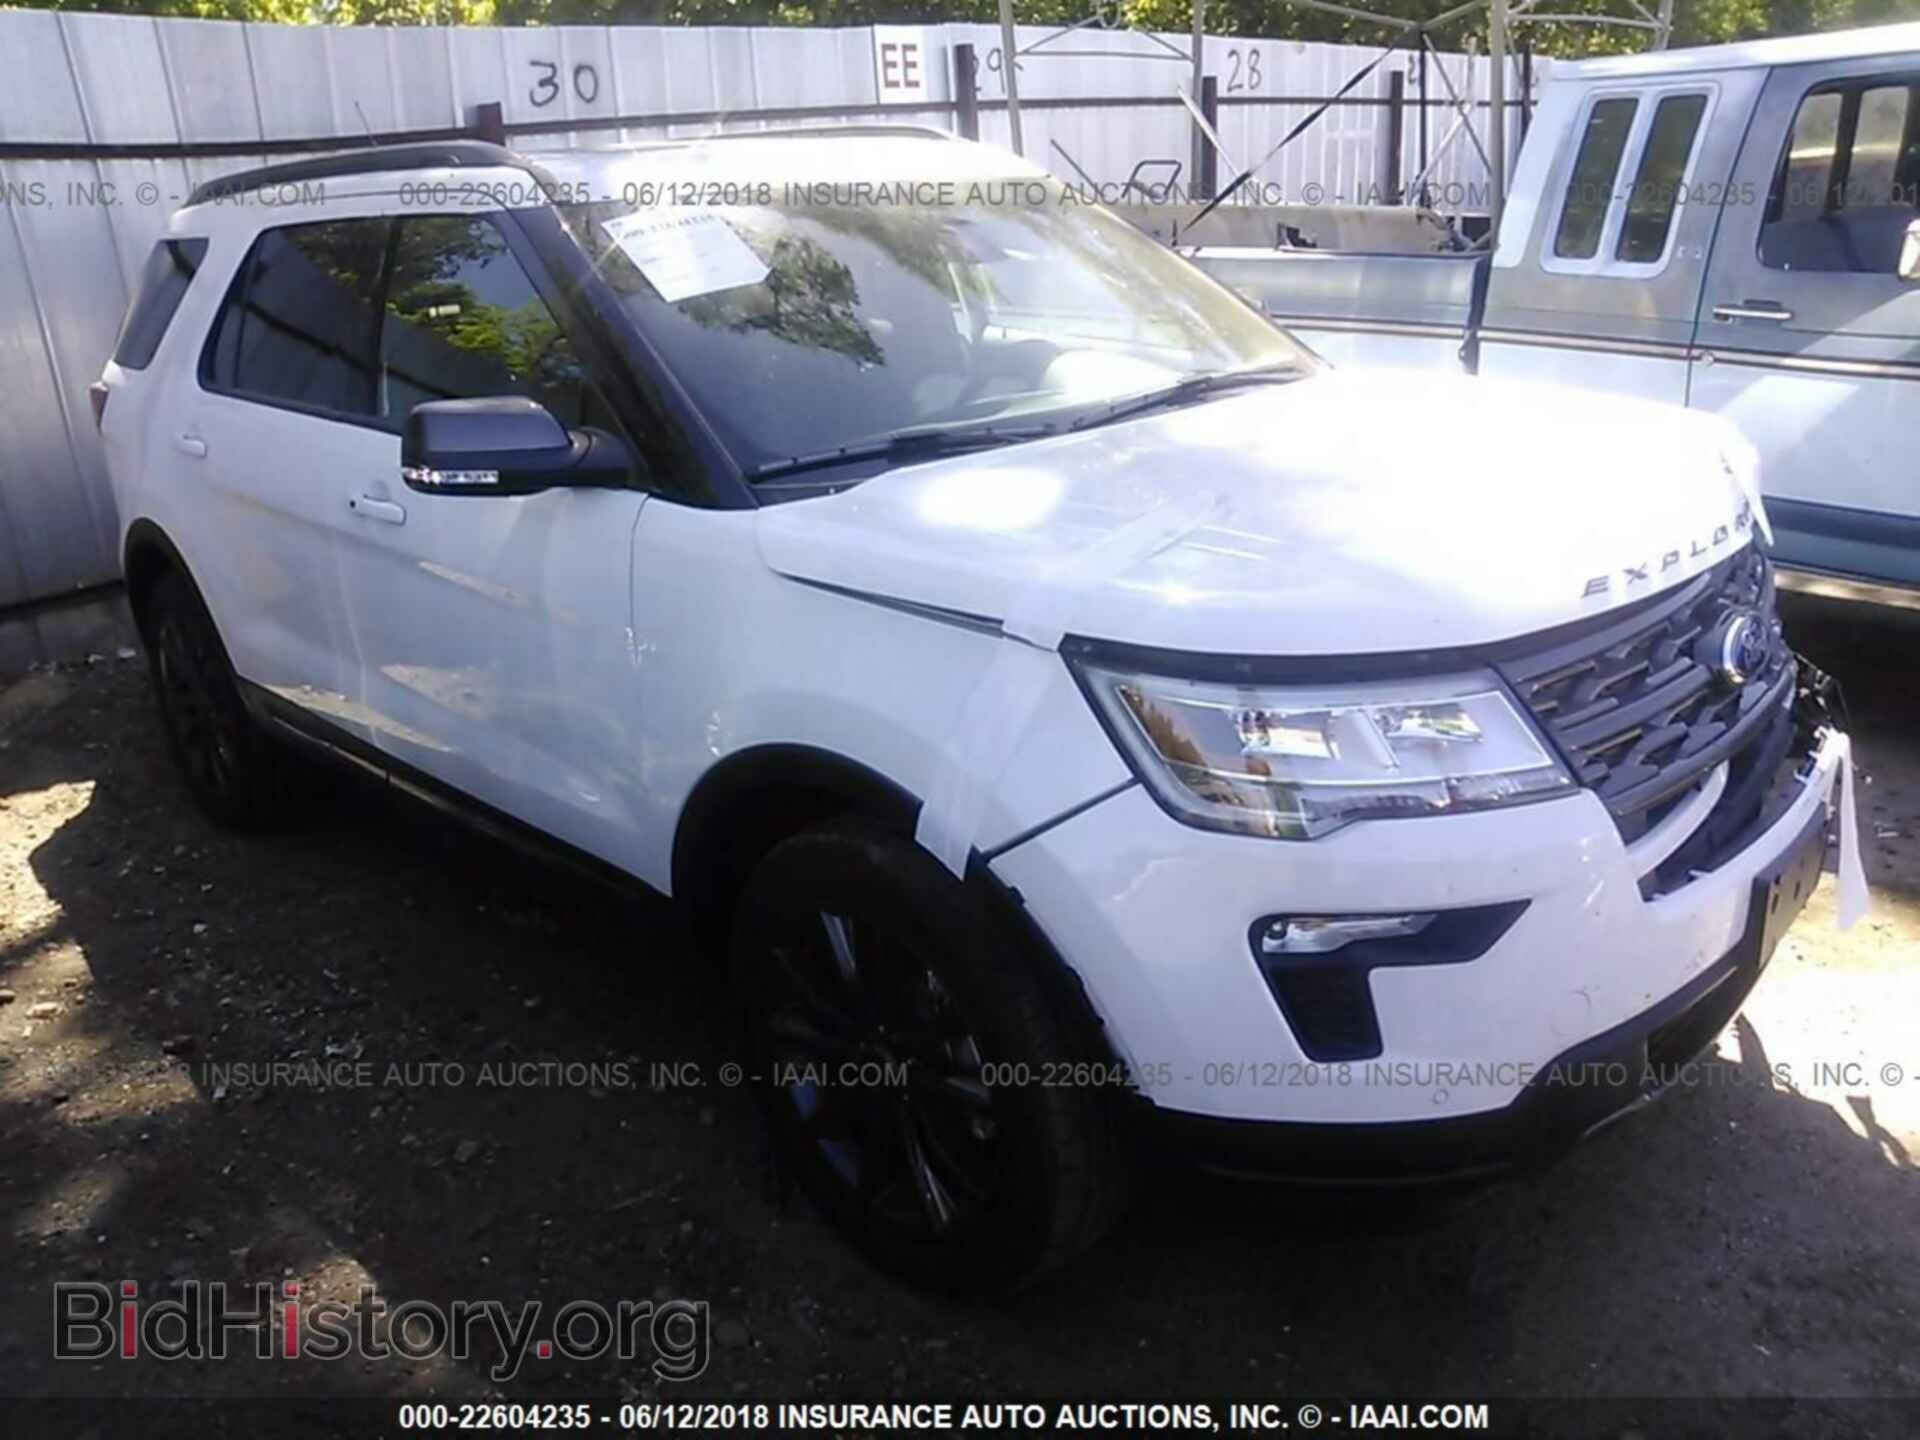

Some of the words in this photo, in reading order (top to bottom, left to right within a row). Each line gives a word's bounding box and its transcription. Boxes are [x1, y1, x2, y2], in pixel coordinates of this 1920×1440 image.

[529, 60, 599, 107] 30
[881, 43, 920, 88] EE
[1226, 49, 1262, 93] 28
